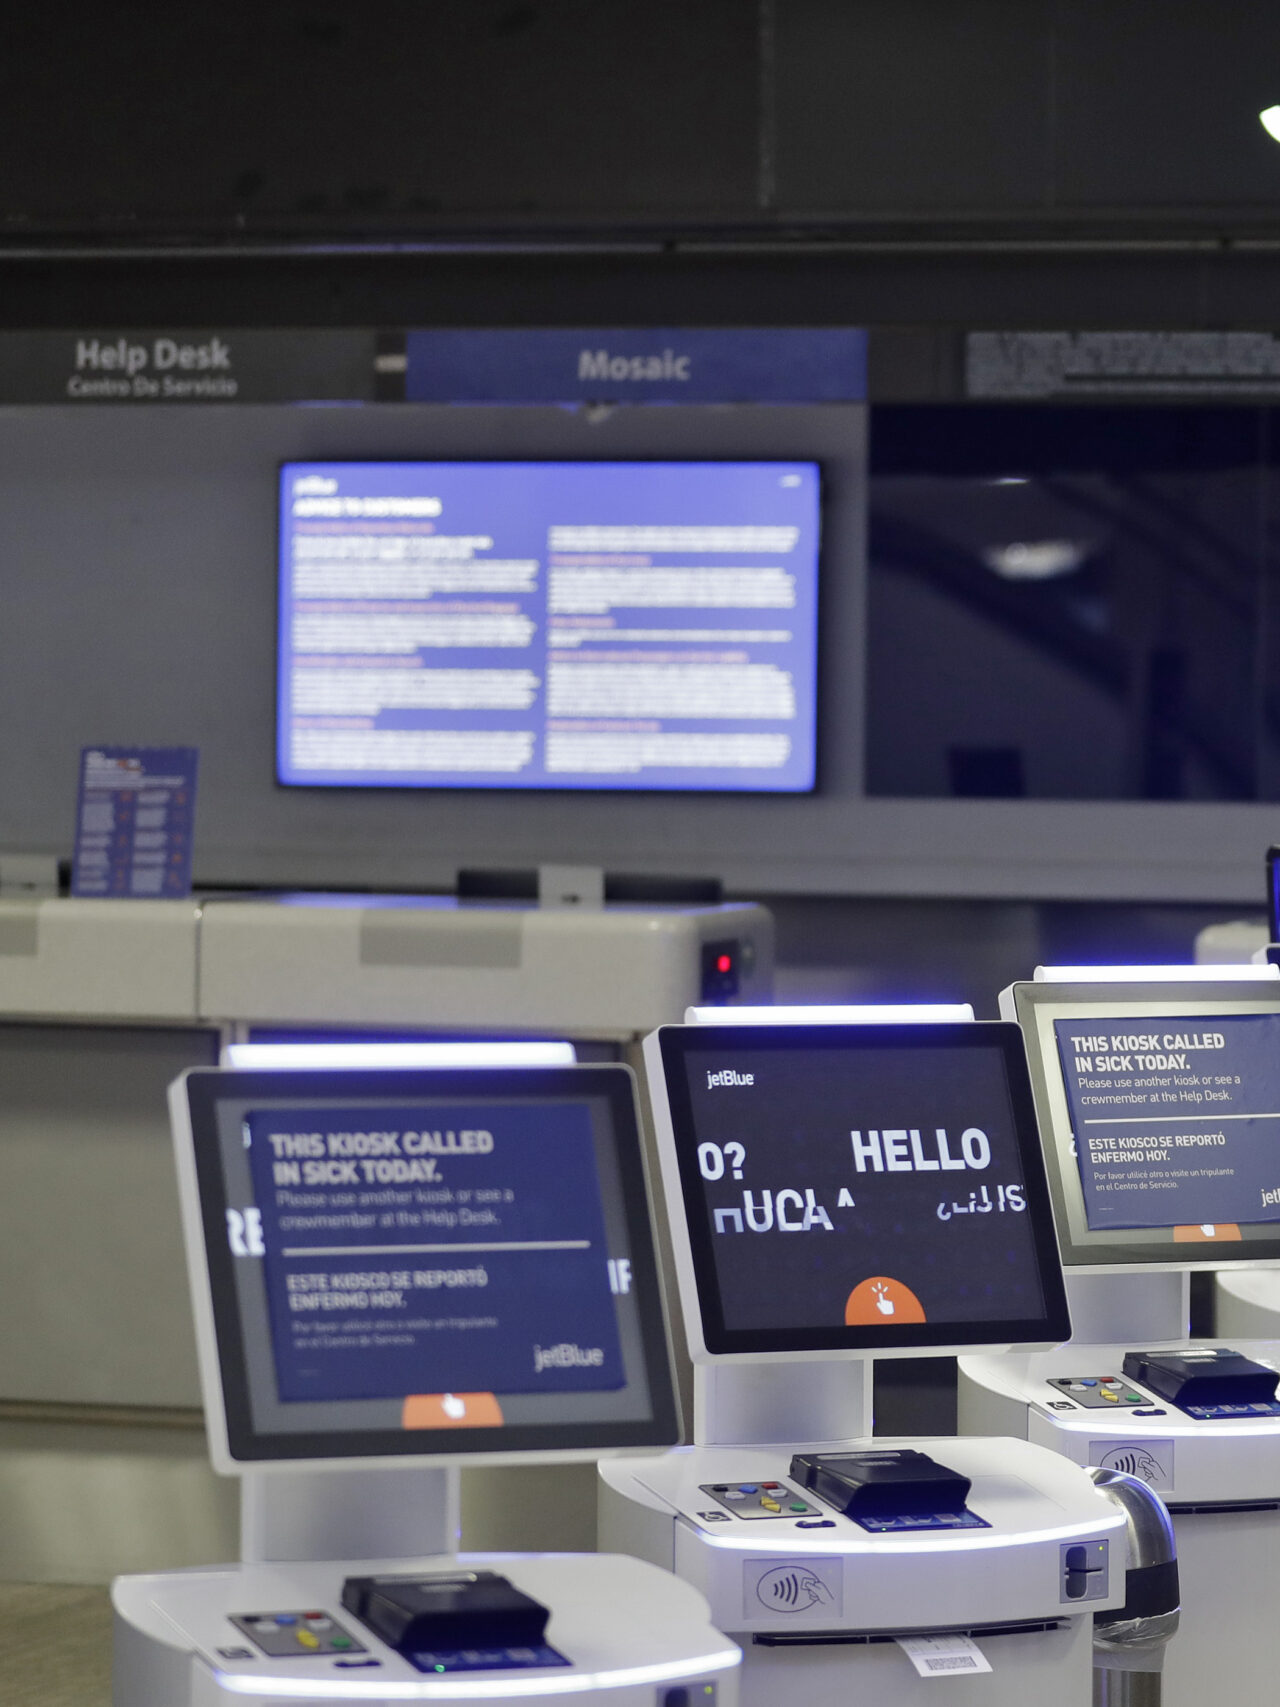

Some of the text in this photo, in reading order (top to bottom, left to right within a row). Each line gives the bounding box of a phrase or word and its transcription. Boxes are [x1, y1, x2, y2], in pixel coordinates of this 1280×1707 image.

[76, 336, 231, 375] Help Desk
[578, 348, 691, 381] Mosaic
[1071, 1033, 1225, 1053] THIS KIOSK CALLED
[1075, 1054, 1191, 1073] IN SICK TODAY.
[706, 1070, 755, 1090] jetBlue
[1078, 1074, 1241, 1089] Please use another kiosk or see a
[1081, 1090, 1233, 1105] crewmember at the Help Desk.
[268, 1132, 325, 1158] THIS
[327, 1131, 402, 1158] KIOSK
[402, 1130, 494, 1156] CALLED
[851, 1128, 991, 1173] HELLO
[1088, 1138, 1117, 1150] ESTE
[1118, 1137, 1158, 1149] KIOSCO
[1159, 1136, 1174, 1147] SE
[1175, 1131, 1226, 1147] REPORTÓ
[1091, 1150, 1171, 1164] ENFERMO HOY.
[272, 1158, 443, 1186] IN SICK TODAY.
[1093, 1171, 1106, 1180] Por
[1107, 1171, 1125, 1180] favor
[1149, 1170, 1164, 1178] otro
[1170, 1169, 1189, 1178] visite
[1200, 1168, 1234, 1178] tripulante
[1106, 1182, 1113, 1190] el
[1114, 1182, 1138, 1190] Centro
[1139, 1181, 1148, 1189] de
[1149, 1181, 1178, 1190] Servicio.
[276, 1187, 514, 1208] Please use another kiosk or see a
[279, 1211, 377, 1231] crewmember
[380, 1211, 395, 1228] at
[396, 1210, 421, 1227] the
[422, 1209, 457, 1228] Help
[286, 1273, 329, 1292] ESTE
[330, 1271, 390, 1291] KIOSCO
[390, 1271, 413, 1290] SE
[288, 1291, 369, 1311] ENFERMO
[533, 1343, 604, 1373] jetBlue
